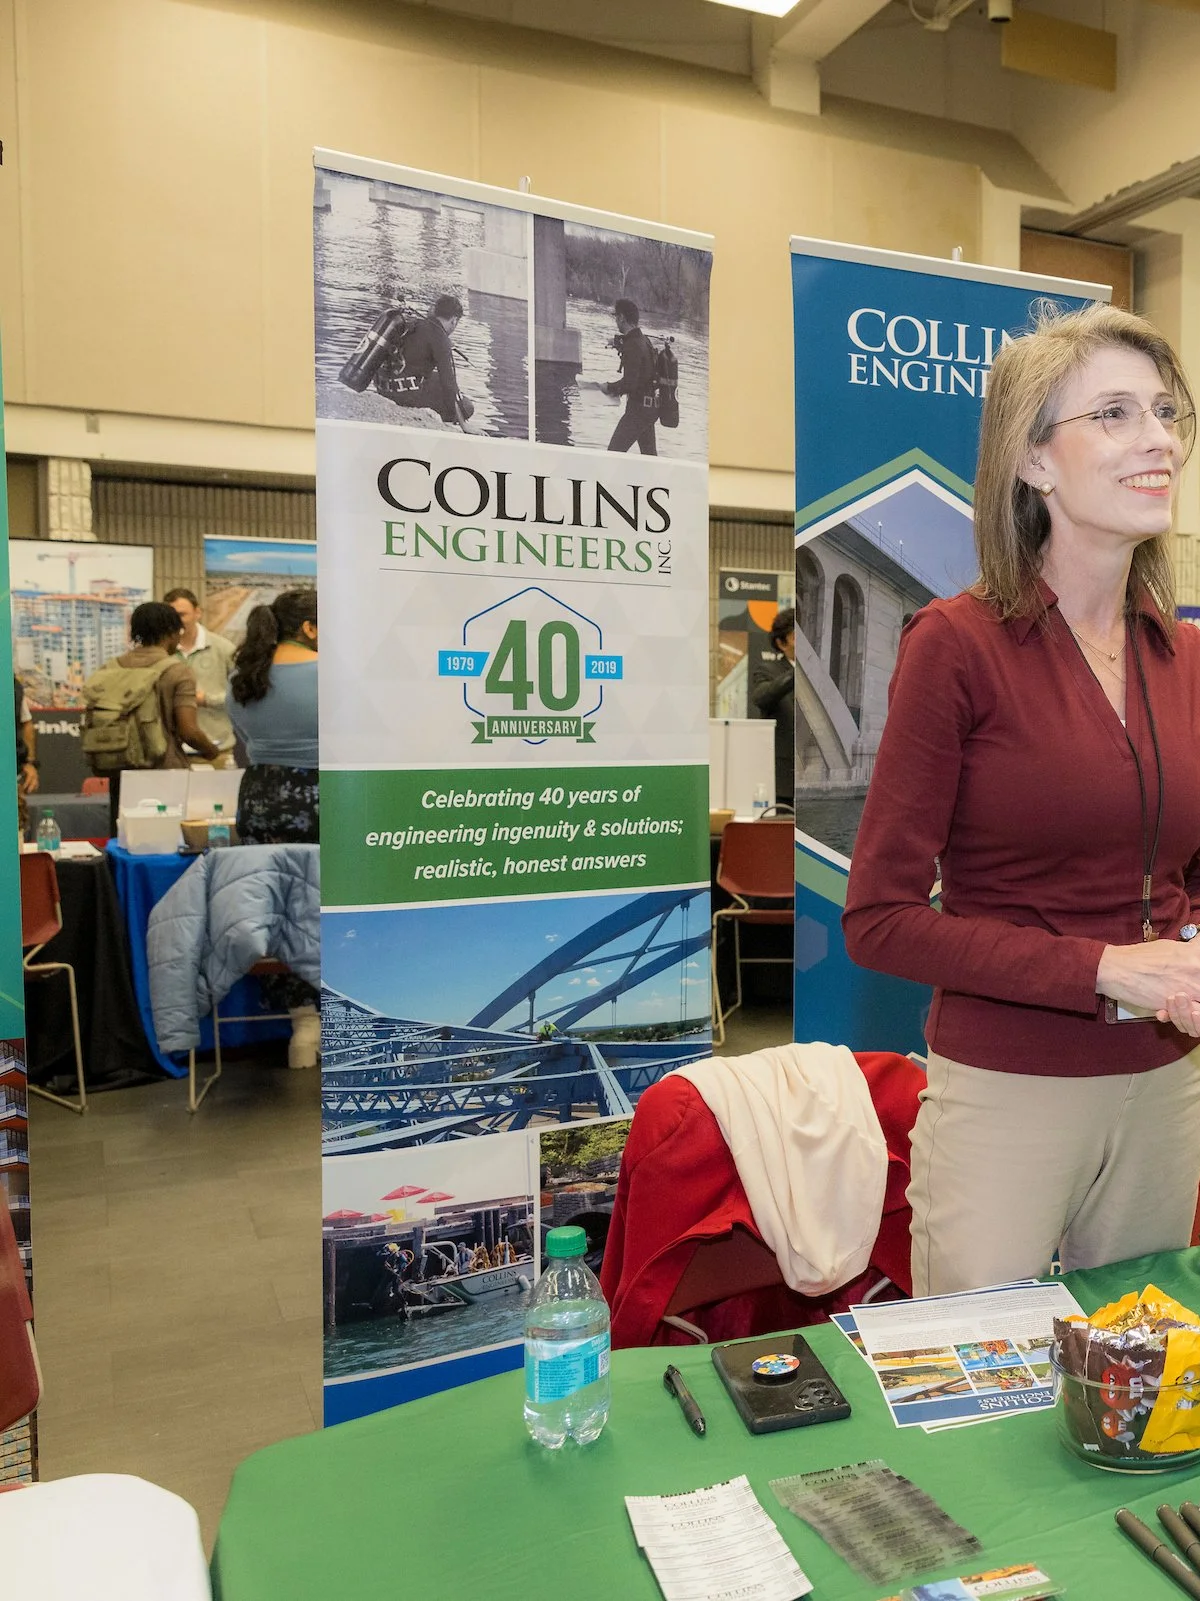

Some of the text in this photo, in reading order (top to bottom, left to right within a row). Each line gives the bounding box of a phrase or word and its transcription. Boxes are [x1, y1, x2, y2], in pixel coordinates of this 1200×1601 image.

[847, 308, 1015, 366] COLLI
[377, 458, 671, 533] COLLINS
[381, 520, 653, 574] ENGINEERS
[657, 538, 672, 575] INC.
[446, 656, 474, 672] 1979
[485, 619, 580, 712] 40
[591, 660, 617, 675] 2019
[491, 719, 578, 736] ANNIVERSARY
[421, 785, 642, 810] Celebrating 40 years of
[365, 816, 684, 850] engineering ingenuity & solutions;
[414, 852, 647, 880] realistic, honest answers
[980, 1395, 1054, 1411] COLLINS
